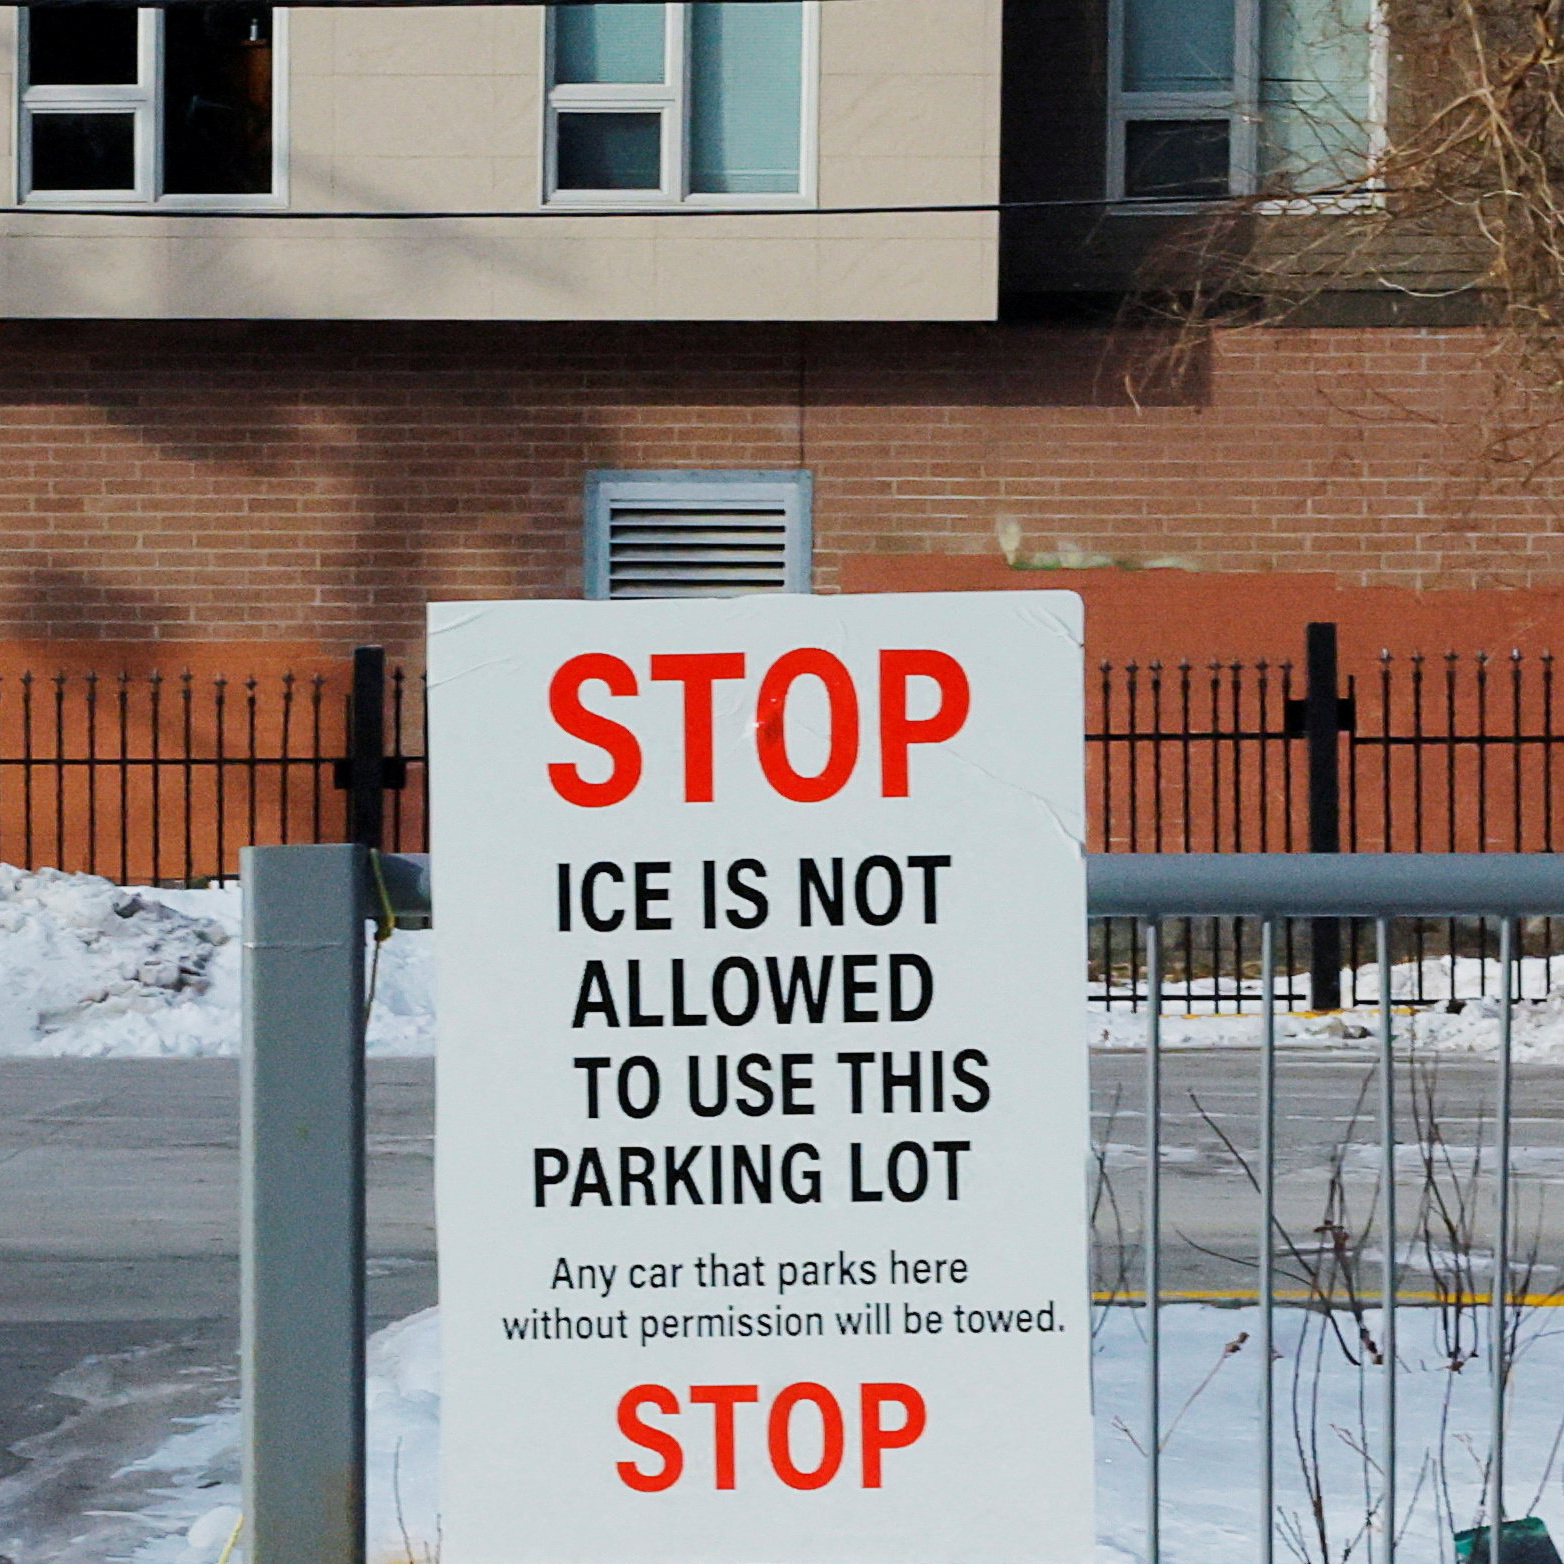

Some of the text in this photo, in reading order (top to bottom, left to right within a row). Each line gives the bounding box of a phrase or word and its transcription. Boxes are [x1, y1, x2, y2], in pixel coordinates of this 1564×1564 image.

[547, 647, 971, 808] STOP
[557, 854, 952, 933] ICE IS NOT
[571, 953, 934, 1029] ALLOWED
[572, 1048, 991, 1120] TO USE THIS
[533, 1140, 972, 1208] PARKING LOT
[550, 1249, 969, 1299] Any car that parks here
[502, 1300, 1066, 1348] without permission will be towed.
[616, 1381, 928, 1493] STOP
